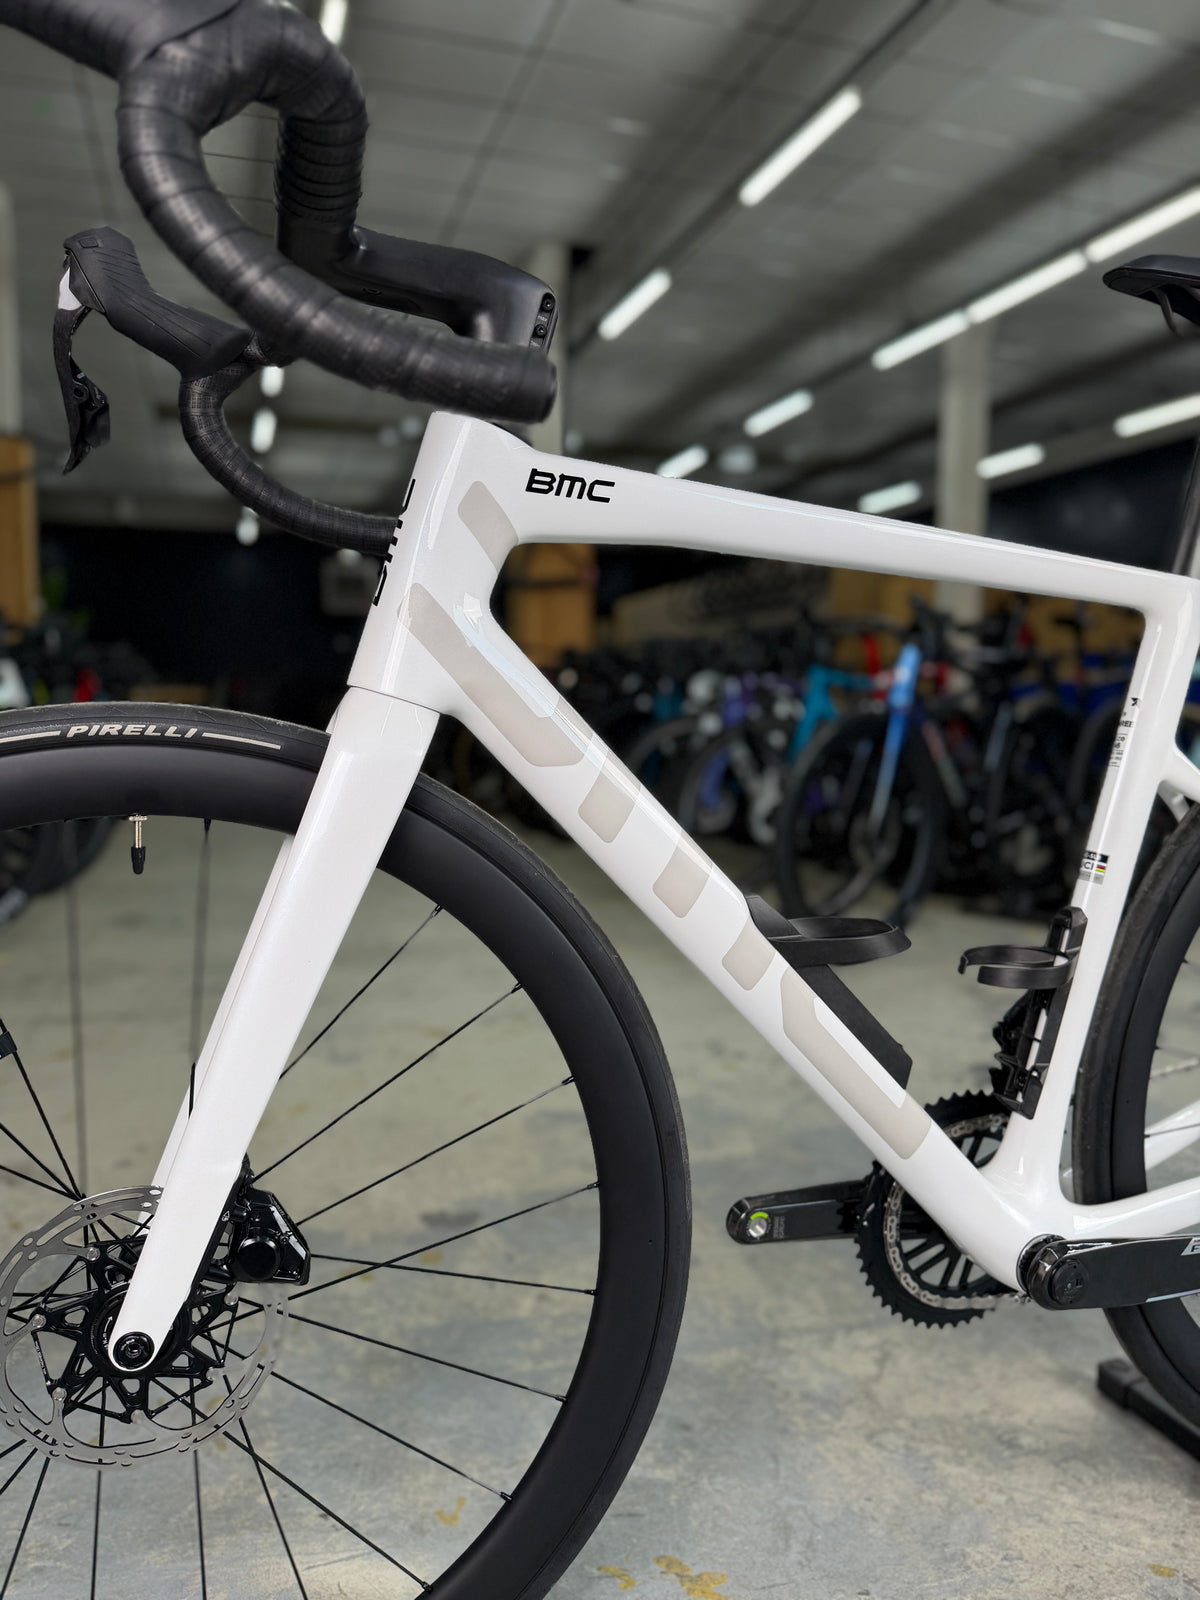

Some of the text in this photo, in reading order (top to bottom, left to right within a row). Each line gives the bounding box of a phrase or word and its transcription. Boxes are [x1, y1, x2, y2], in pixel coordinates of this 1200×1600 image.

[525, 468, 616, 503] BMC
[66, 724, 198, 738] PIRELLI
[1081, 861, 1095, 870] CI
